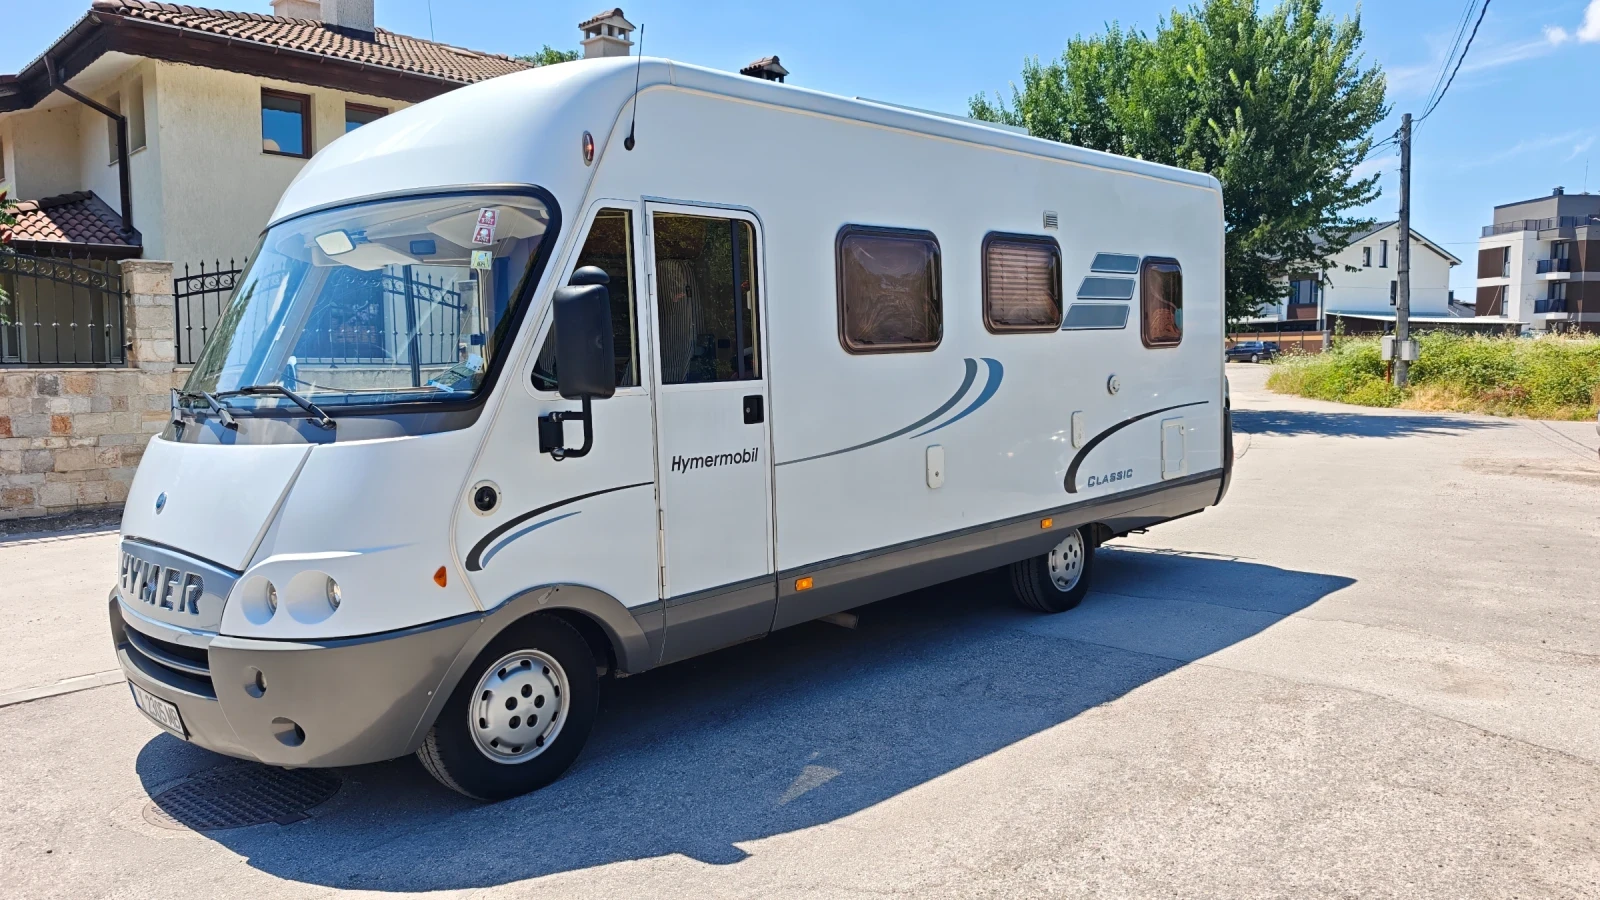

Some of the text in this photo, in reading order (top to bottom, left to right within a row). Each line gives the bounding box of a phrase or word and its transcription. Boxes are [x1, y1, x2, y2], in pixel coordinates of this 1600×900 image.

[671, 447, 759, 474] Hymermobil
[1087, 468, 1133, 488] CLASSIC
[121, 551, 204, 615] HYMER
